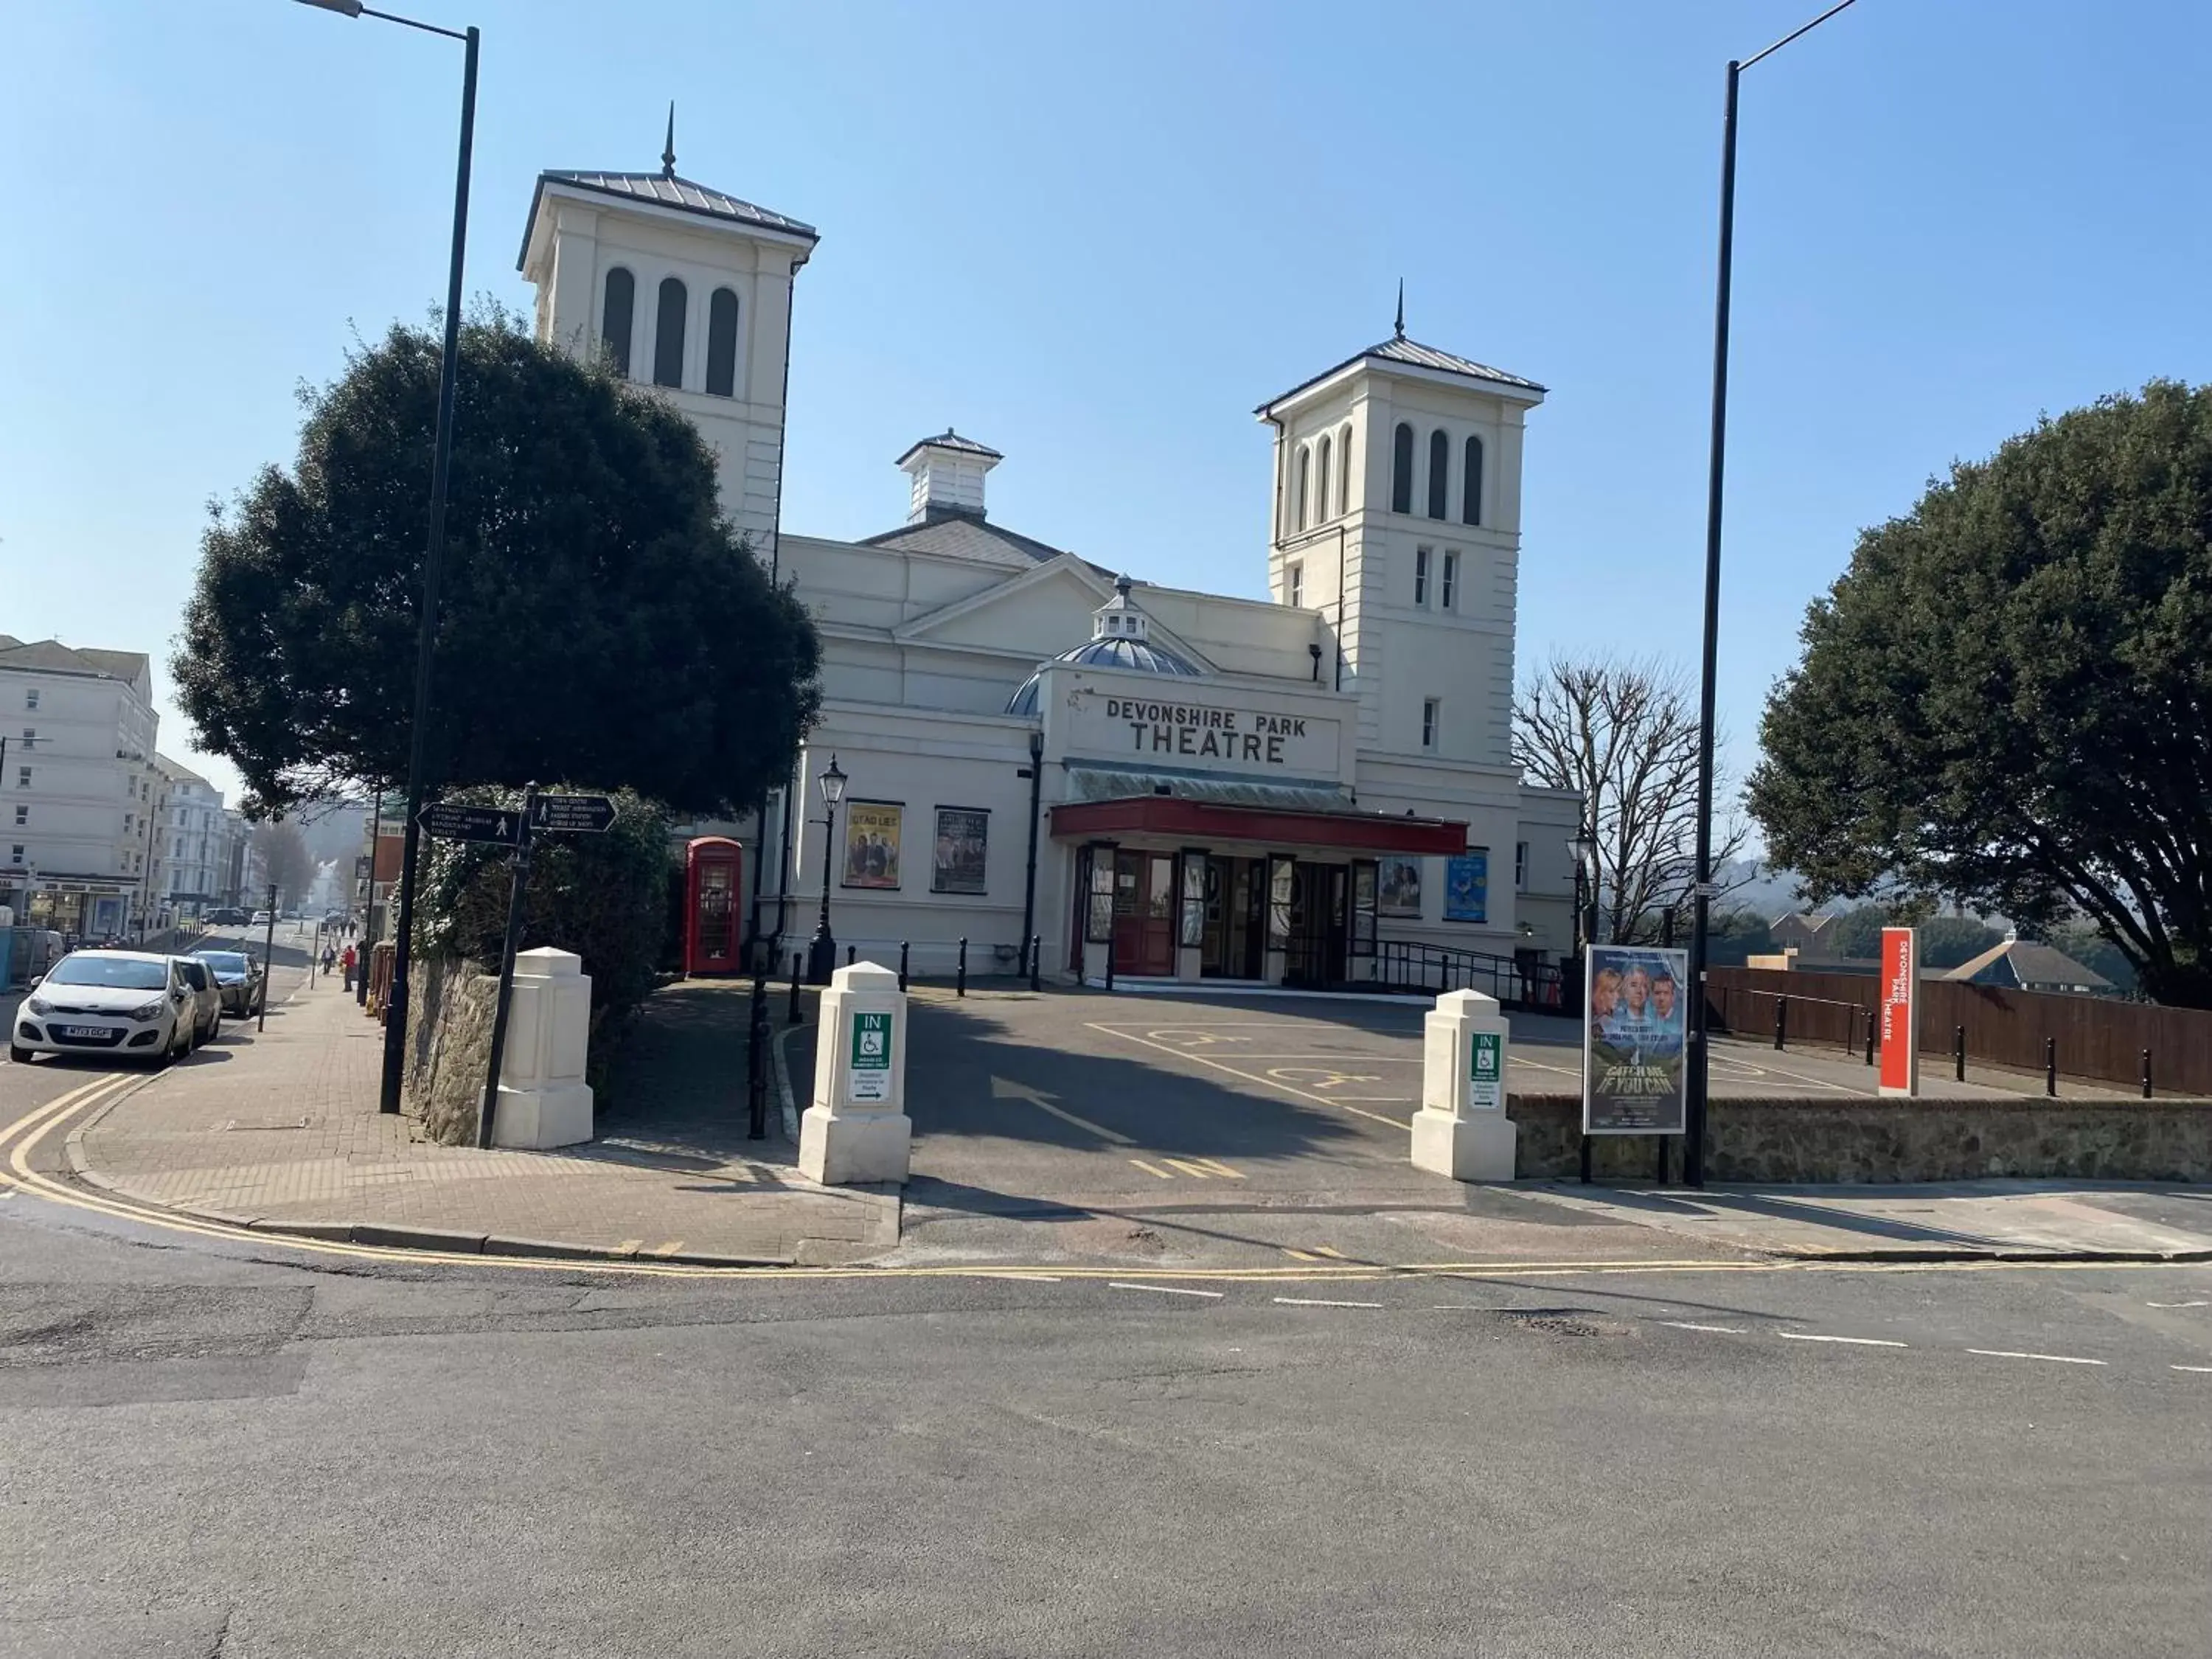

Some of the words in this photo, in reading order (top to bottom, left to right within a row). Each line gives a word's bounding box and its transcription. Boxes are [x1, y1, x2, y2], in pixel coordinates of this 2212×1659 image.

[1107, 700, 1235, 729] DEVONSHIRE
[1256, 715, 1307, 738] PARK
[1130, 722, 1287, 764] THEATRE
[1899, 941, 1908, 1003] DEVONSHIRE
[1891, 979, 1899, 1004] PARK
[865, 1015, 881, 1029] IN
[1883, 998, 1893, 1043] THEATRE
[1480, 1035, 1493, 1048] IN
[1605, 1065, 1646, 1077] CATCH
[1646, 1065, 1668, 1077] ME
[1595, 1077, 1615, 1094] IF
[1615, 1077, 1642, 1094] YOU
[1645, 1077, 1676, 1094] CAN
[1127, 1158, 1248, 1179] IN
